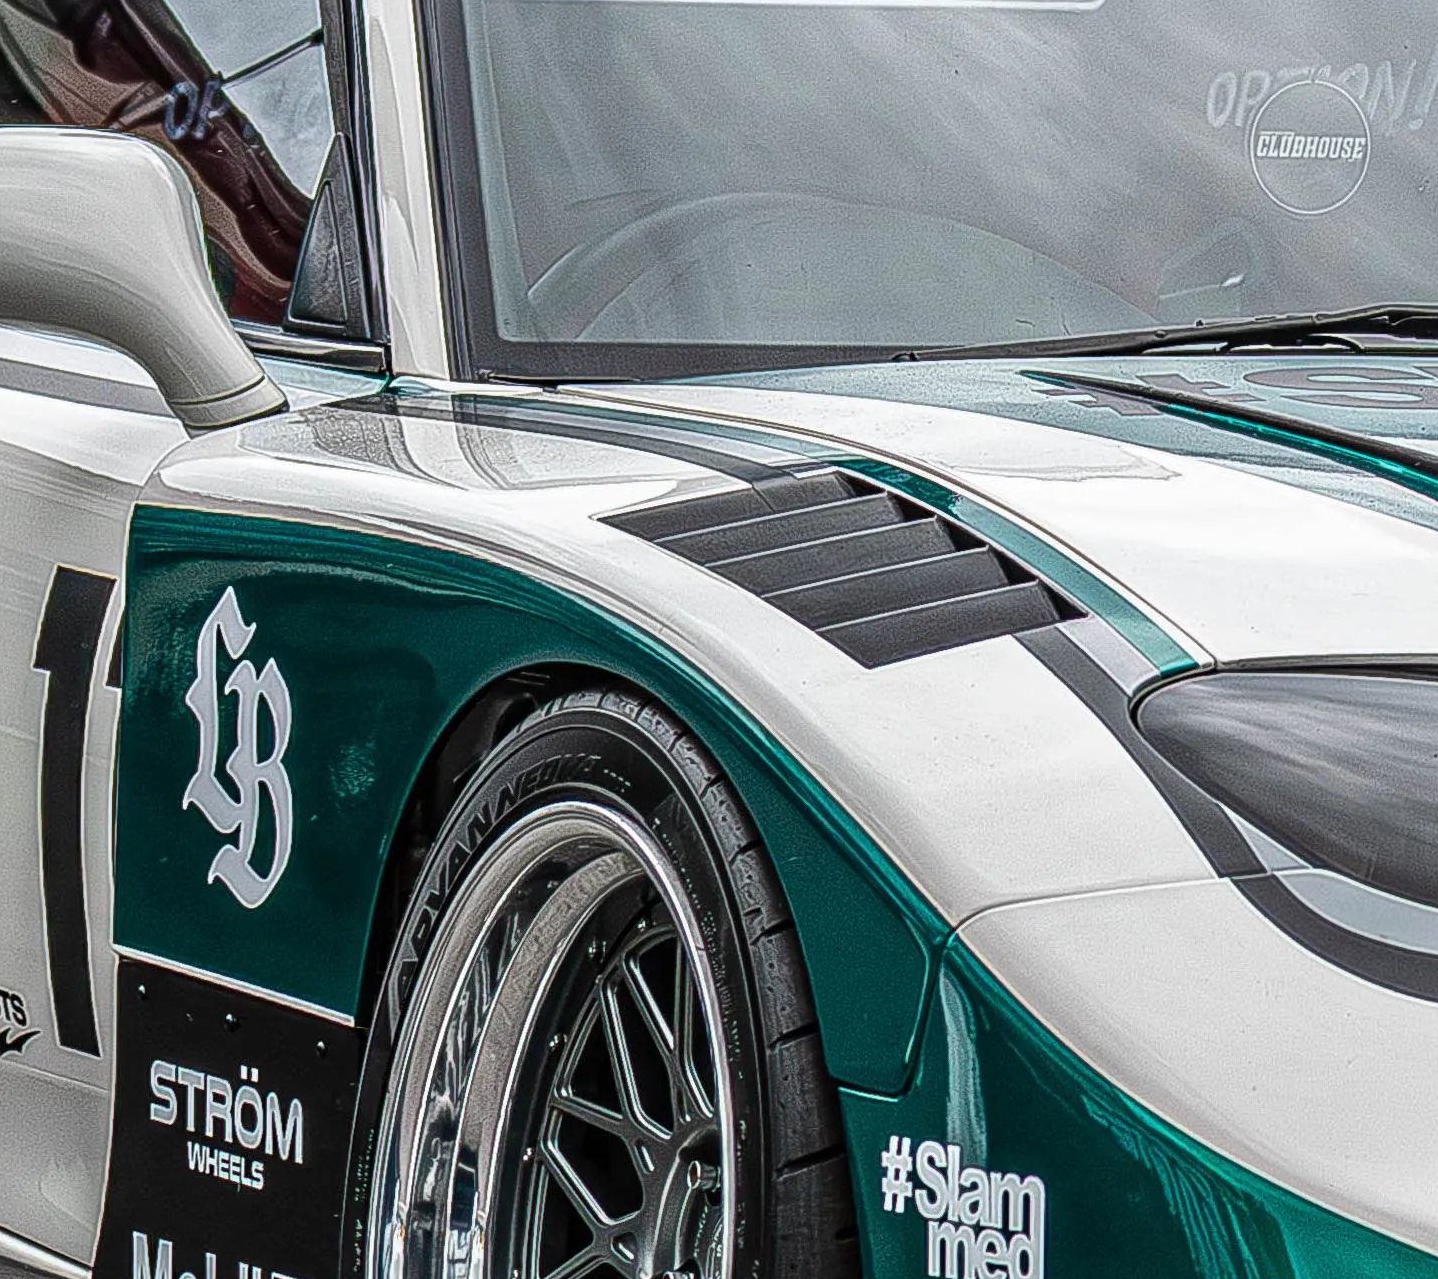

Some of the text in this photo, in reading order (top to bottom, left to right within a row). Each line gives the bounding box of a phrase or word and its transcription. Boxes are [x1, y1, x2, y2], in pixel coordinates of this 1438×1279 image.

[1256, 130, 1366, 162] CLUBHOUSE
[150, 1059, 304, 1165] STRÖM
[187, 1140, 264, 1190] WHEELS
